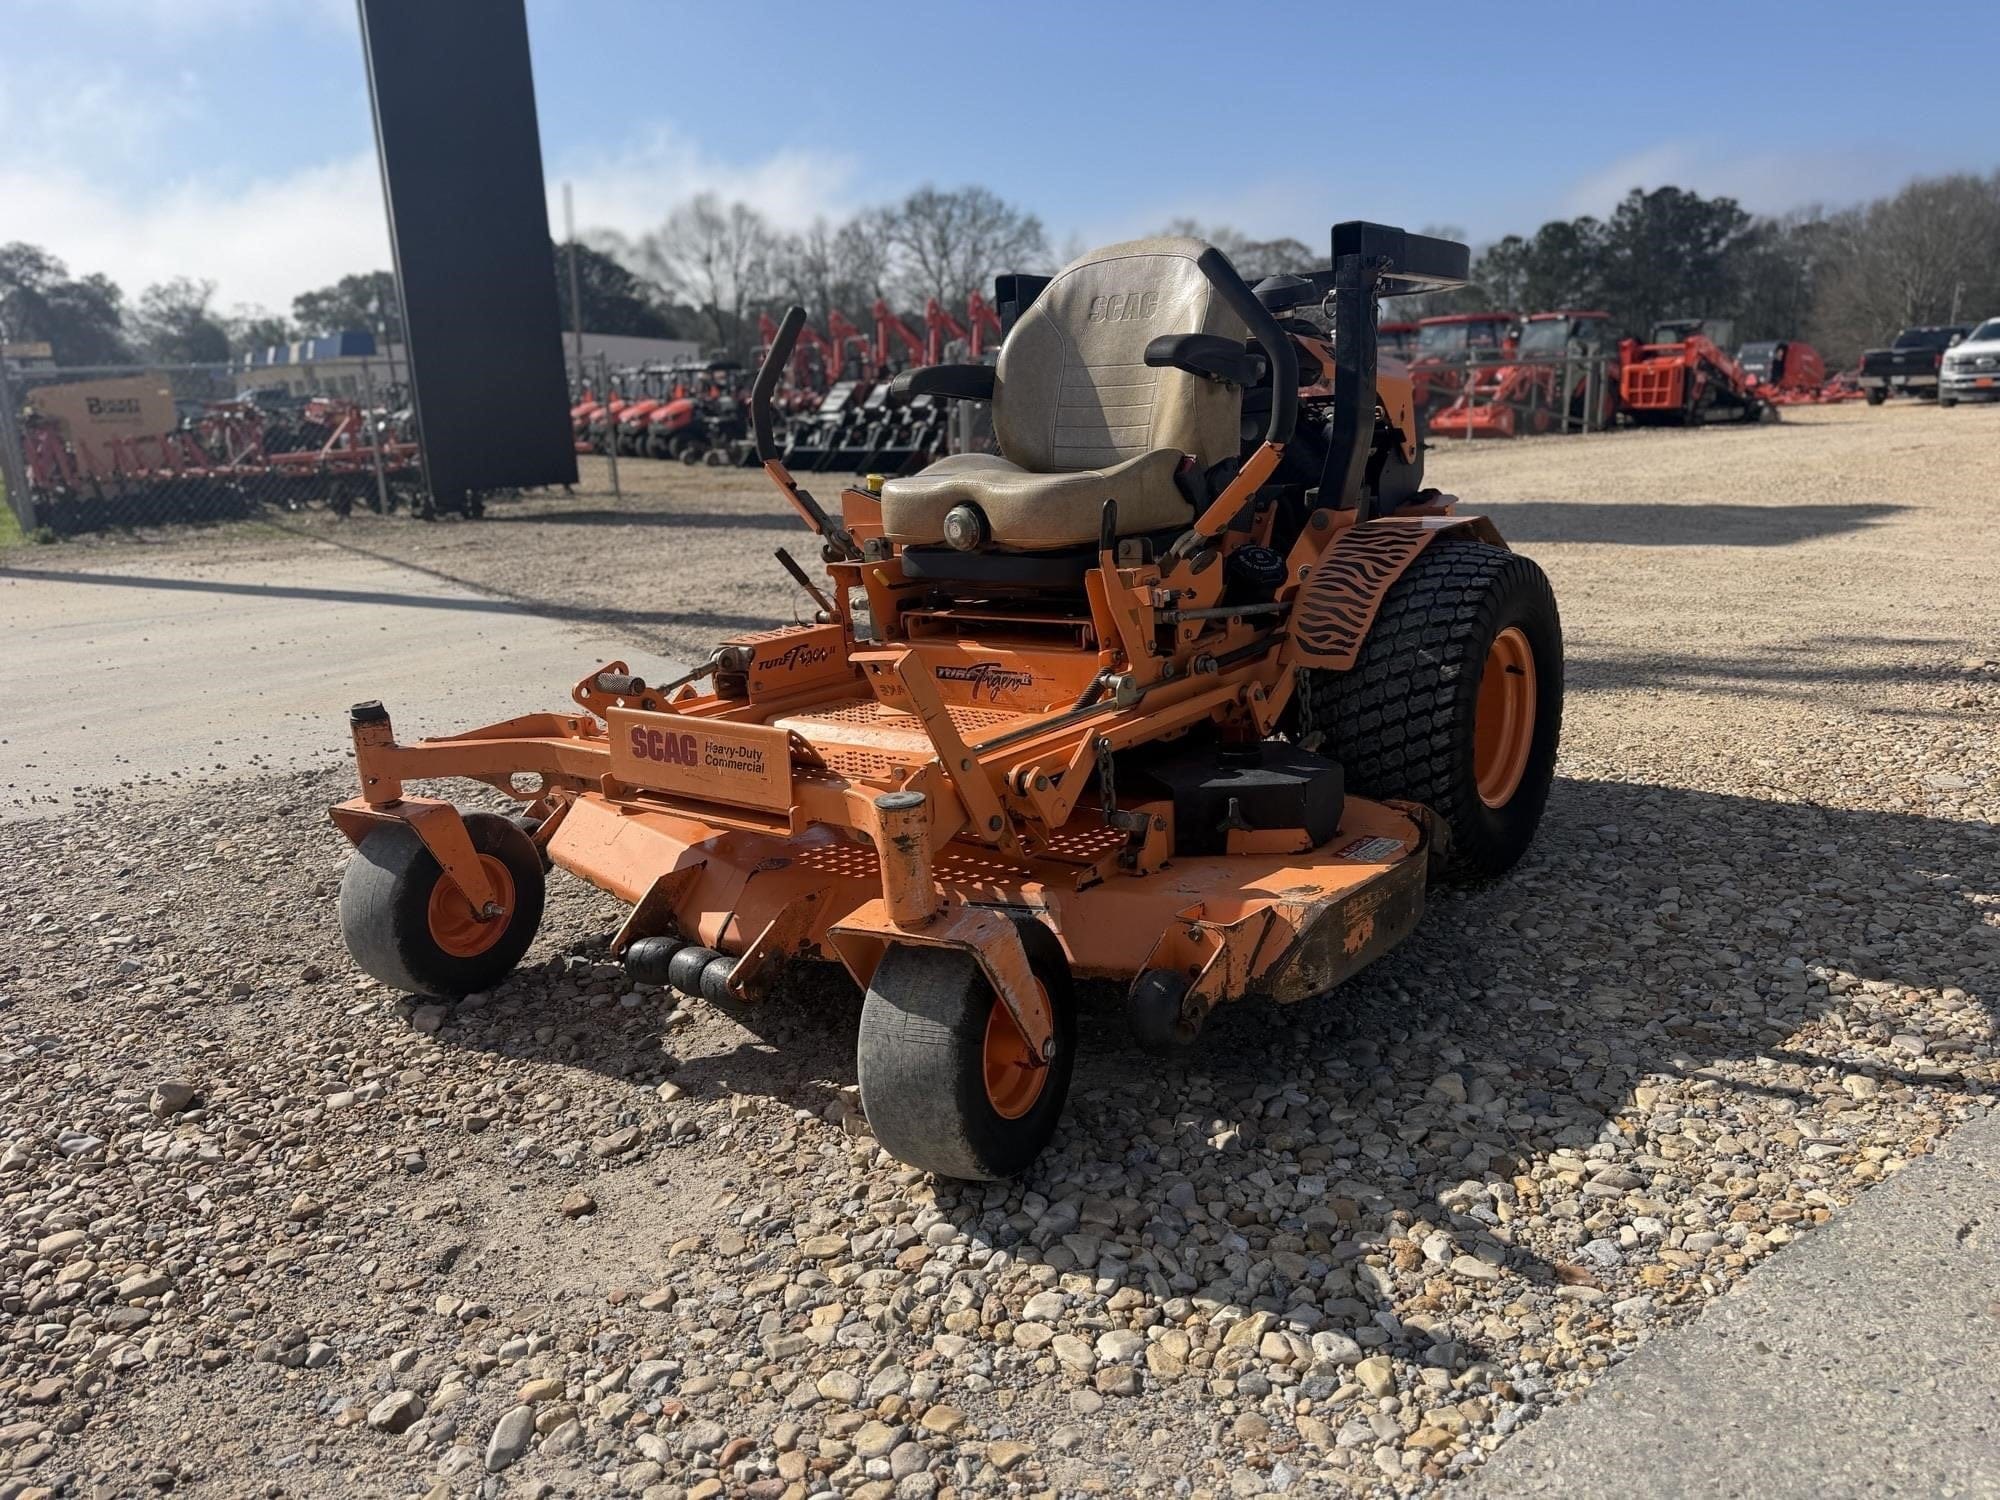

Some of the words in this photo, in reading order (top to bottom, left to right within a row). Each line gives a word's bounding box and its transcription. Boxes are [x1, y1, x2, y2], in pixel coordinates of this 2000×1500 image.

[1088, 292, 1160, 323] SCAG
[631, 726, 699, 767] SCAG
[705, 741, 763, 763] Heavy-Duty
[705, 754, 765, 774] Commercial
